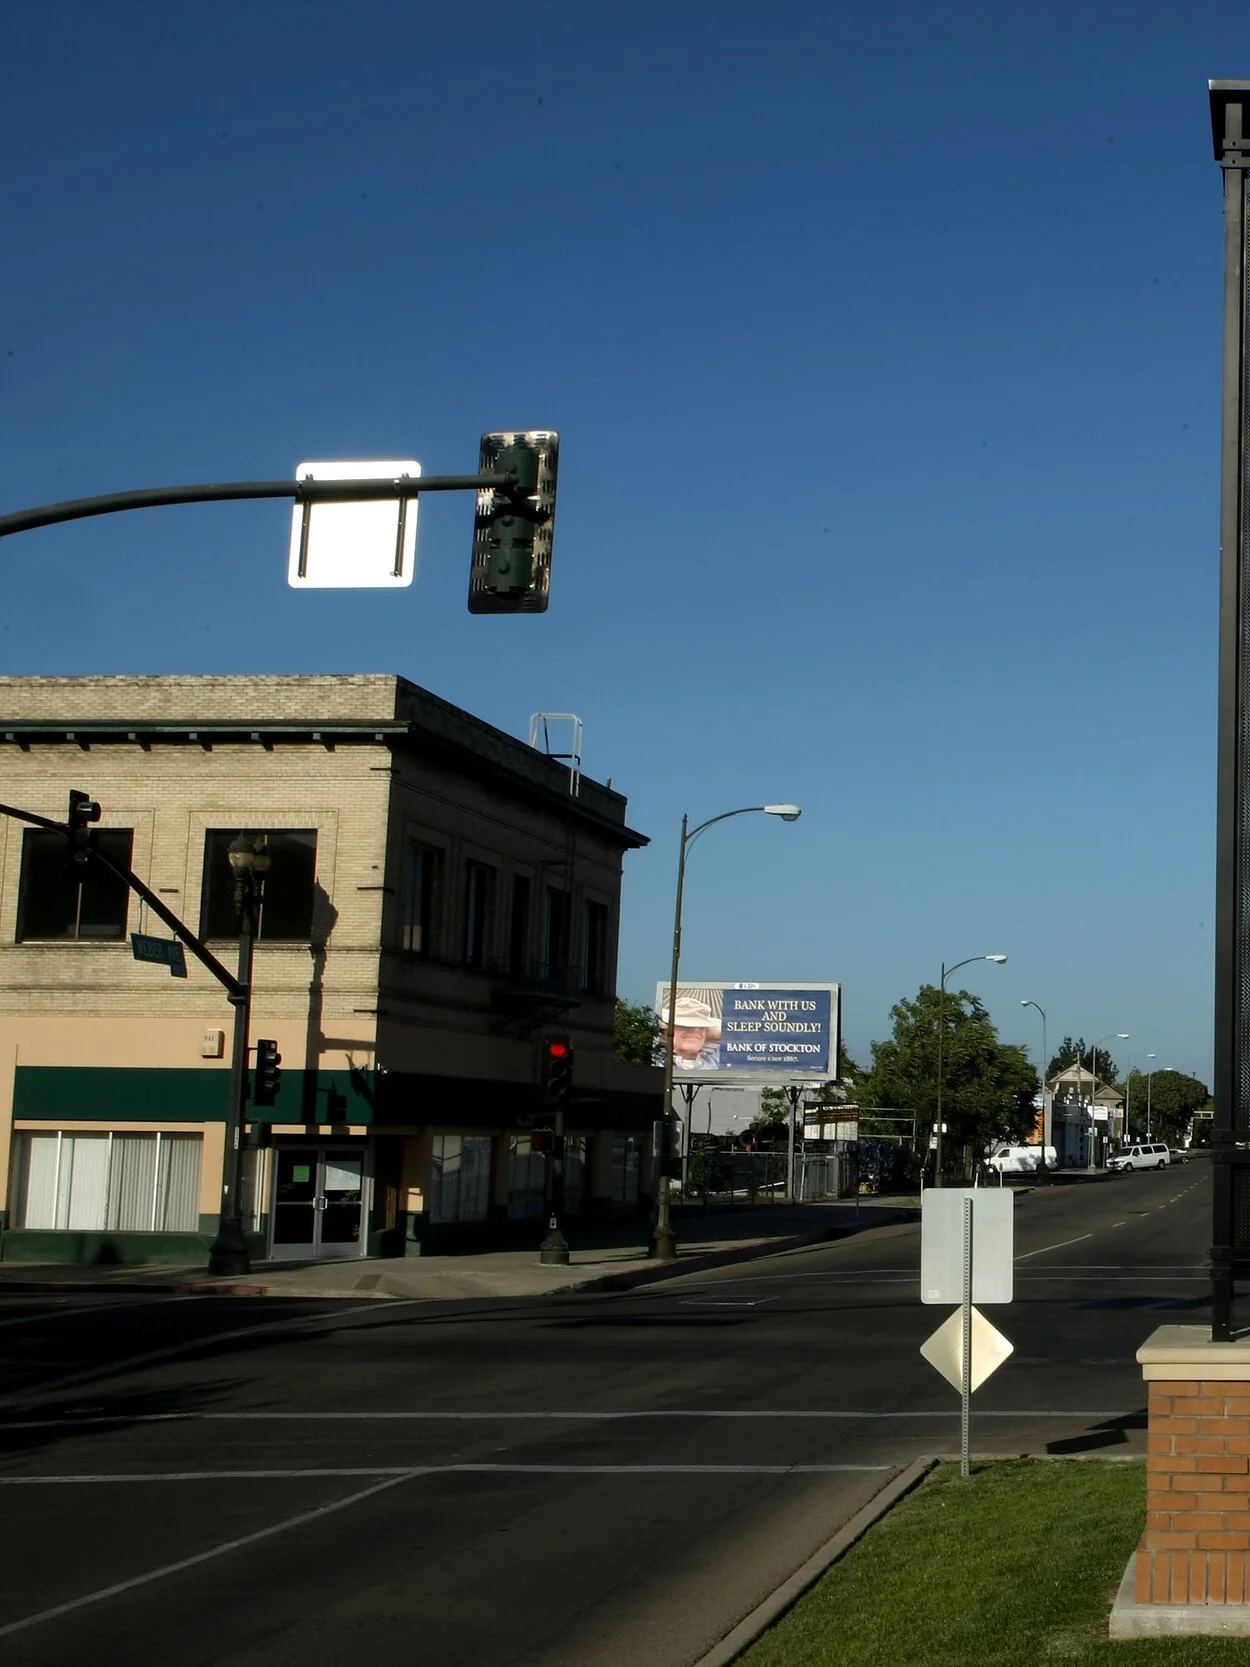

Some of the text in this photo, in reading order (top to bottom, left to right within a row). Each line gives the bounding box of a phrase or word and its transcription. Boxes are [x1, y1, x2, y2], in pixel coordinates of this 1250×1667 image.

[734, 1000, 816, 1011] BANK WITH US
[762, 1011, 787, 1021] AND
[727, 1021, 821, 1033] SLEEP SOUNDLY!
[727, 1043, 820, 1053] BANK OF STOCKTON
